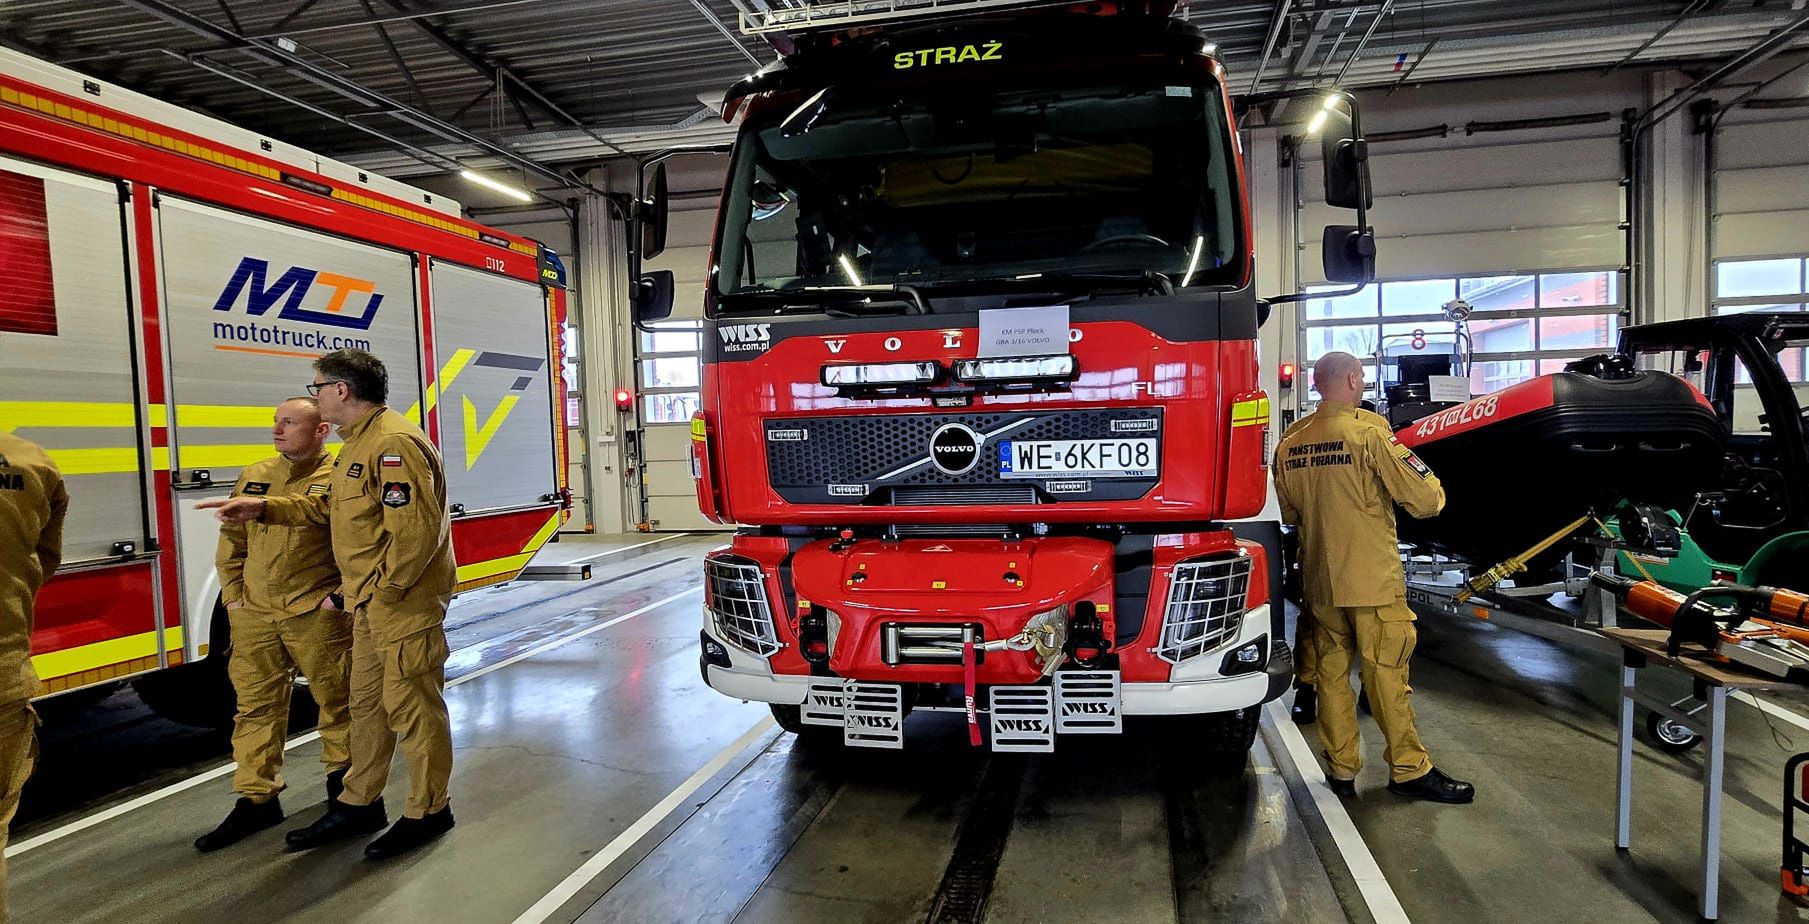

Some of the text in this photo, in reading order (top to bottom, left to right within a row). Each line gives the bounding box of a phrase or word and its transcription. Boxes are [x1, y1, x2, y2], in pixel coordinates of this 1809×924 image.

[894, 40, 1002, 69] STRAŻ
[492, 259, 505, 272] 112
[213, 322, 370, 351] mototruck.com
[718, 323, 771, 343] WISS
[1411, 328, 1426, 350] 8
[724, 341, 770, 352] wiss.com.pl
[935, 445, 974, 453] VOLVO
[1019, 442, 1149, 470] WE 6KF08
[1288, 441, 1344, 457] PAŃSTWOWA
[1310, 454, 1352, 467] POŻARNA
[1064, 702, 1108, 714] WISS
[998, 720, 1042, 731] WISS
